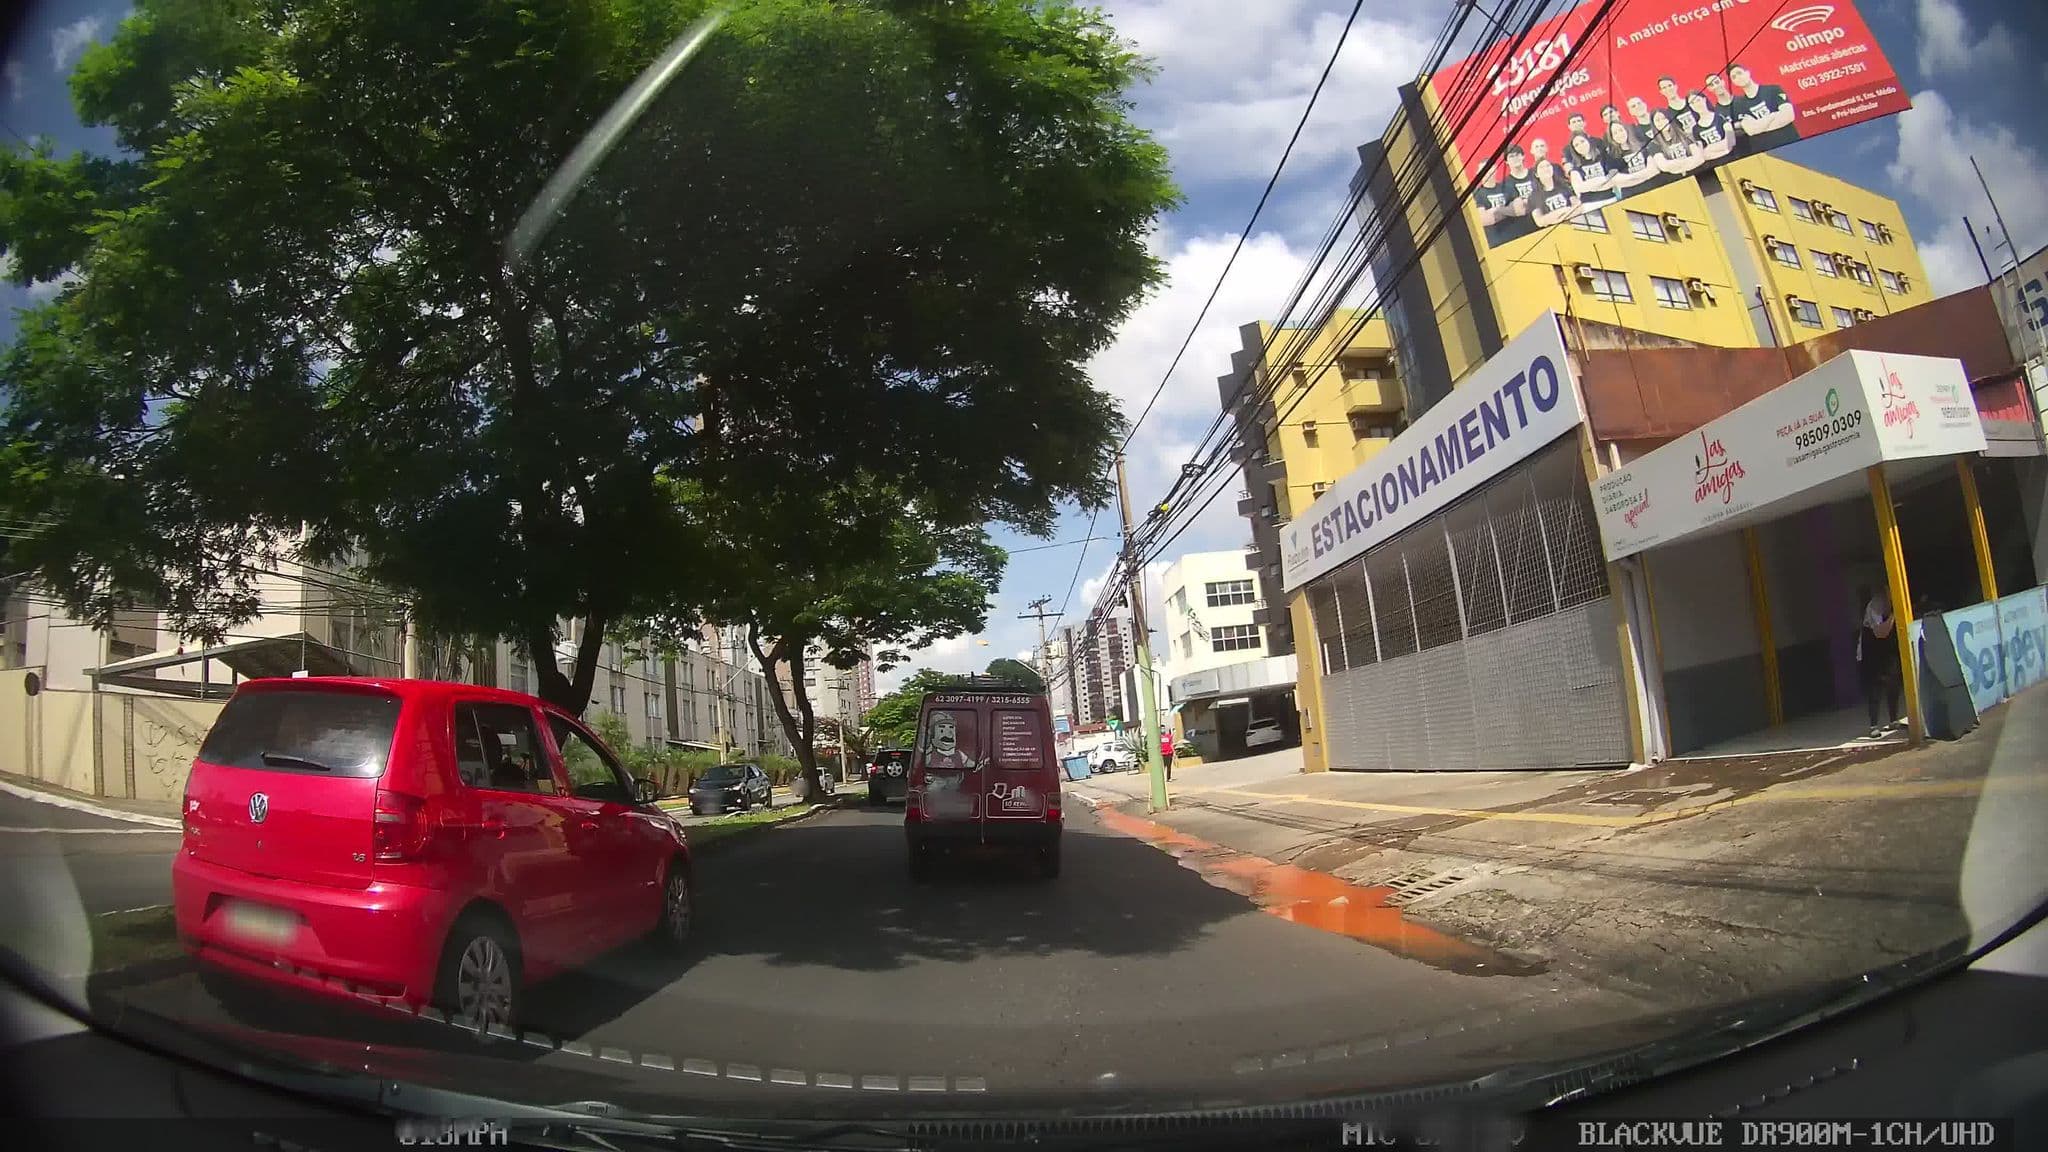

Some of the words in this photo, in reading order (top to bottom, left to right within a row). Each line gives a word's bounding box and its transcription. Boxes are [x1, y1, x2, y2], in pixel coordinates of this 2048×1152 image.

[1616, 36, 1628, 49] A
[1629, 21, 1670, 44] maior
[1671, 8, 1710, 27] força
[1711, 0, 1734, 13] em
[1786, 27, 1845, 52] olimpo
[1831, 44, 1868, 60] abertas
[1797, 76, 1818, 91] (62)
[1819, 61, 1868, 84] 3922-7501
[1562, 96, 1577, 109] 10
[1795, 410, 1862, 450] 98509.0309
[1311, 355, 1559, 559] ESTACIONAMENTO
[1696, 431, 1728, 485] Las
[1695, 460, 1745, 504] amigas
[945, 695, 985, 704] 3097-4199
[991, 696, 1032, 705] 3215-6555
